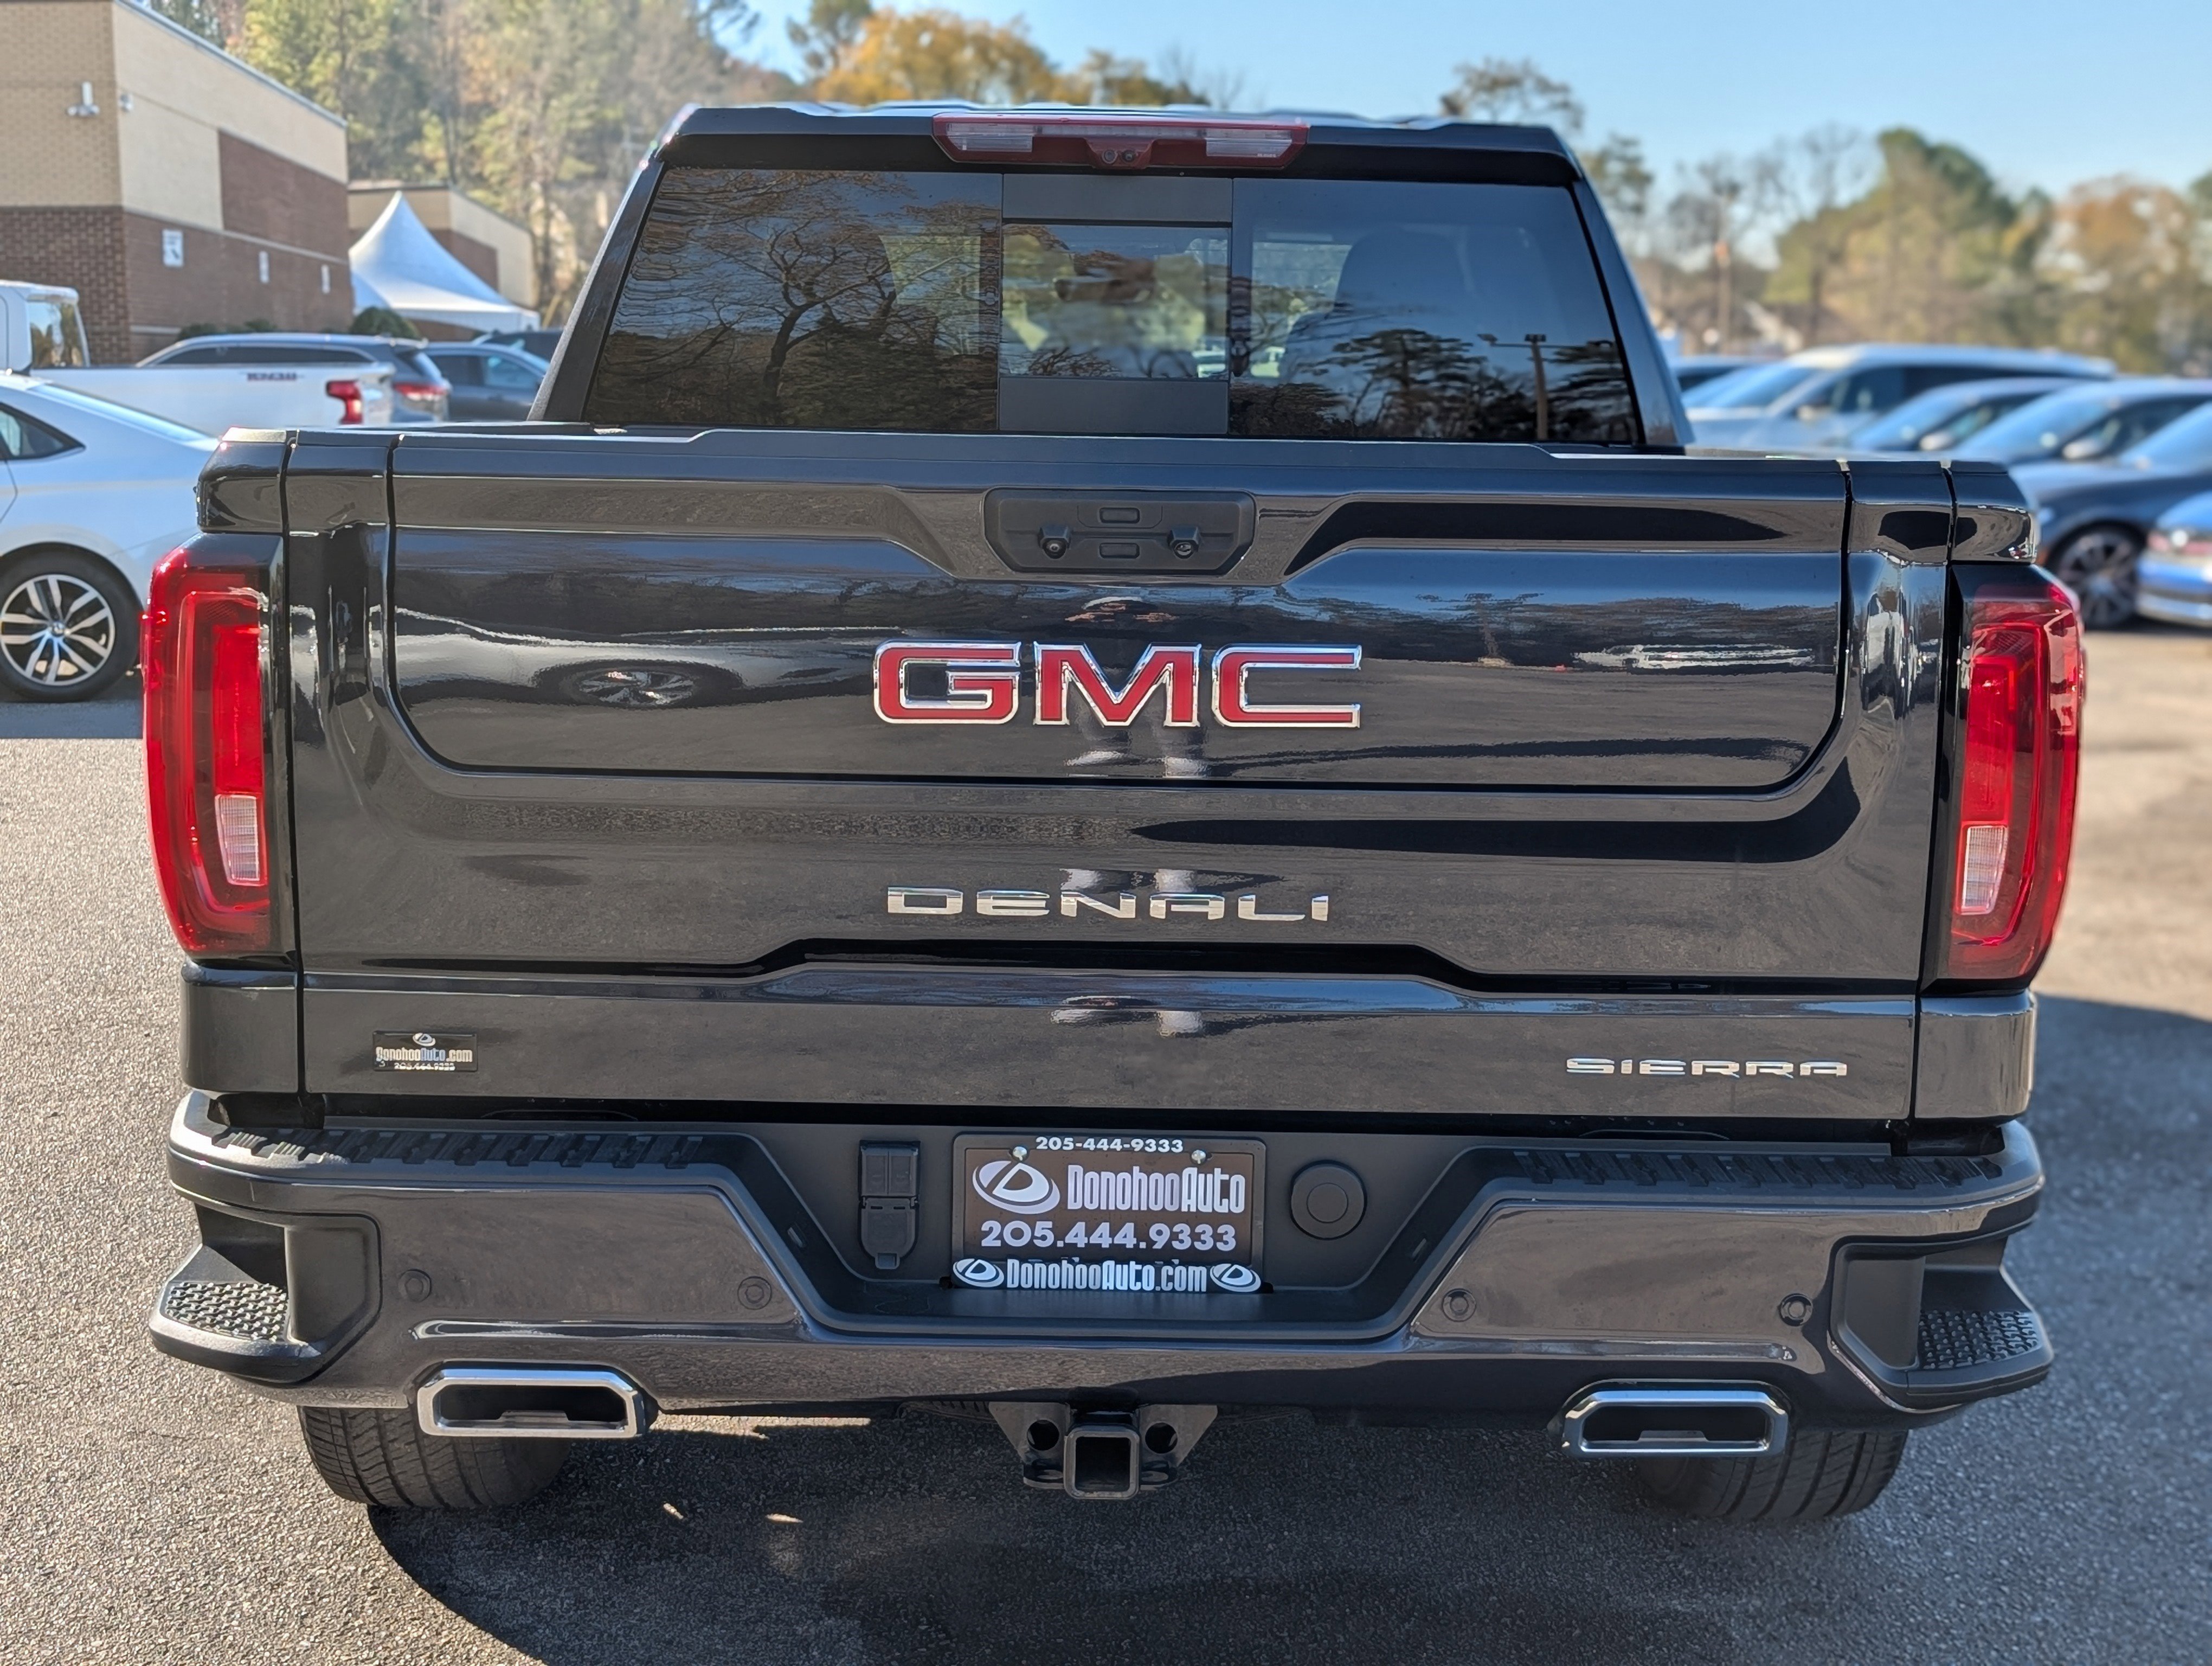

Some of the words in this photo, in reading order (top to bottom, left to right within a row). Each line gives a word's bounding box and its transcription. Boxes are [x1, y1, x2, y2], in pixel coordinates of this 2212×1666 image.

[872, 638, 1363, 729] GMC
[887, 886, 1329, 922] DENALI
[375, 1046, 473, 1062] DonohooAuto.com
[1566, 1058, 1848, 1079] SIERRA
[1036, 1136, 1184, 1154] 205-444-9333
[1067, 1164, 1246, 1214] DonohooAuto
[980, 1220, 1237, 1252] 205.444.9333
[1006, 1258, 1207, 1292] DonohooAuto.com
